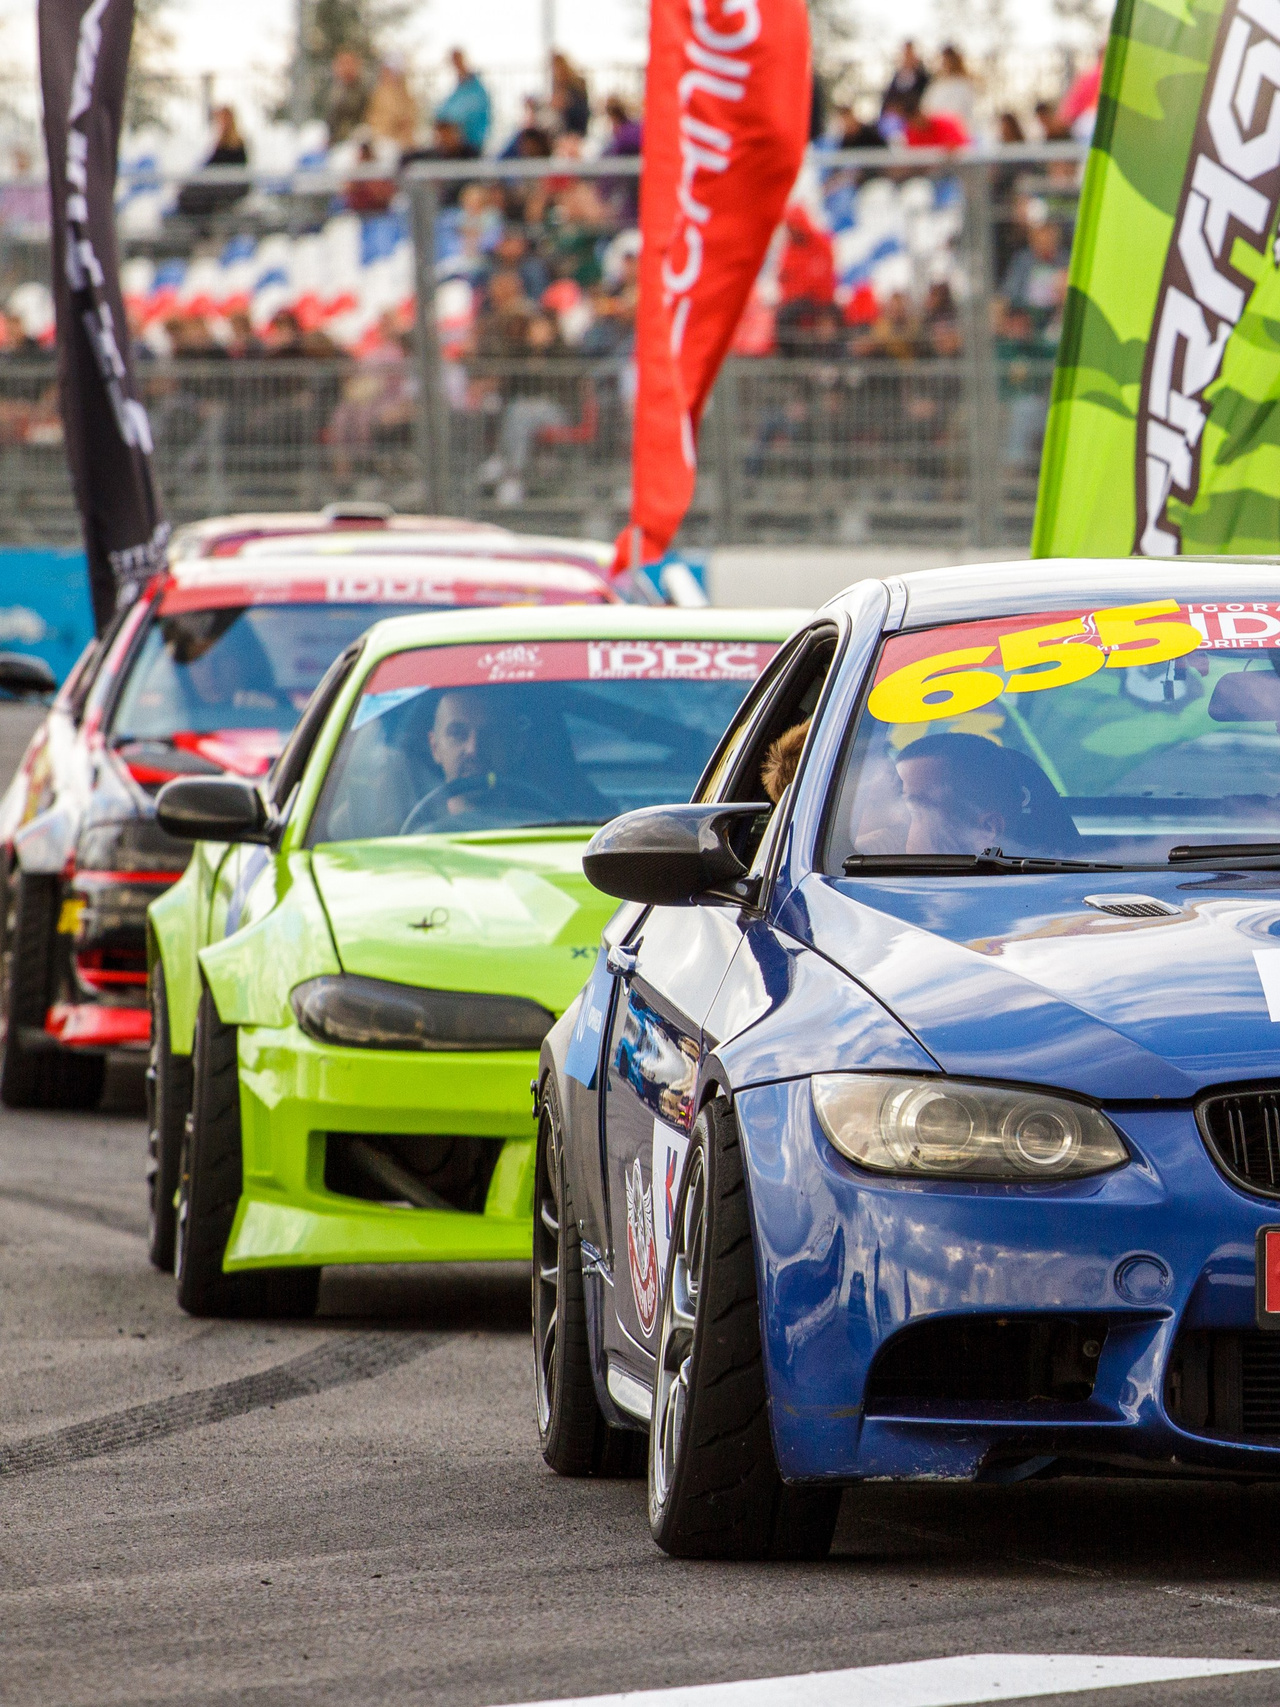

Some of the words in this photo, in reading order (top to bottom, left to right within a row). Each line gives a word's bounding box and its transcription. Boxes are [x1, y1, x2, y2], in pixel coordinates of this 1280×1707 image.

[1199, 638, 1268, 650] DRIFT
[588, 648, 758, 671] IDDC
[867, 598, 1203, 723] 655
